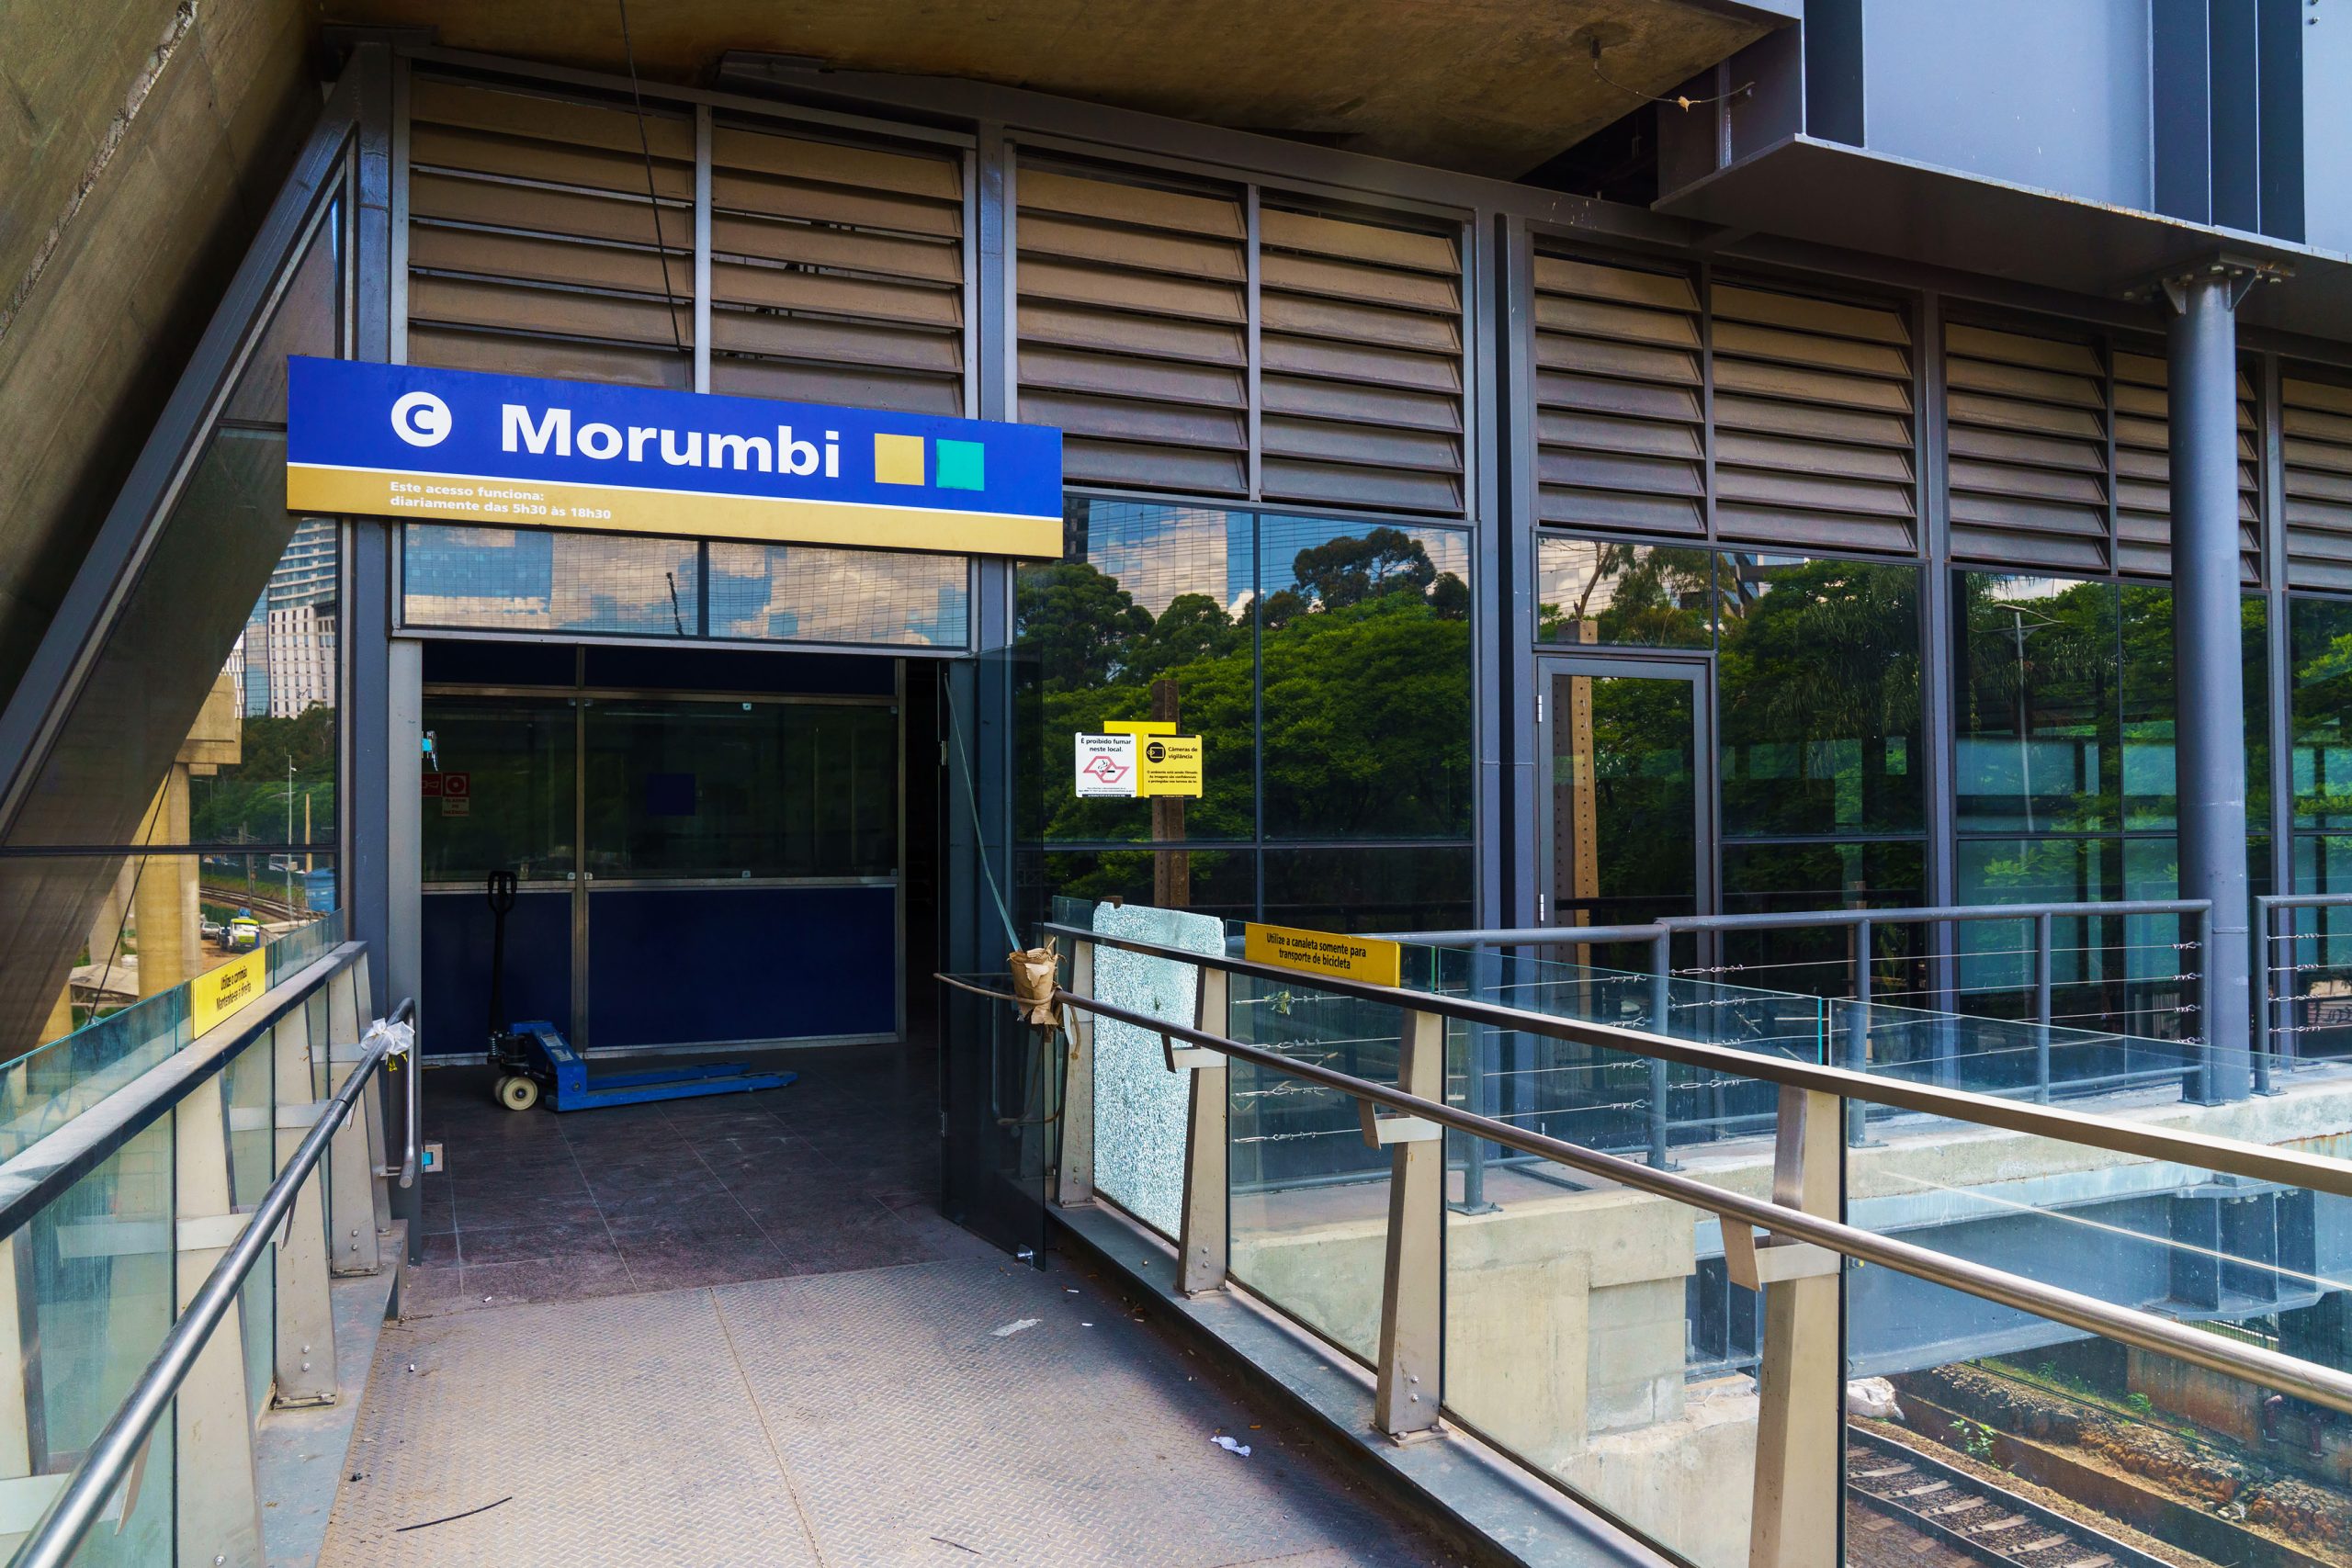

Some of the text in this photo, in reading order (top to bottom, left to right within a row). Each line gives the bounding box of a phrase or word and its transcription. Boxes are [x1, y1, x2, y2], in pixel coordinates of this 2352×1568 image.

[502, 403, 840, 478] Morumbi
[390, 481, 544, 502] Este acesso funciona:
[390, 496, 612, 520] diariamente das 5h30 às 18h30
[1266, 932, 1367, 958] Utilize a canaleta somente para
[1279, 948, 1351, 969] transporte de bicicleta
